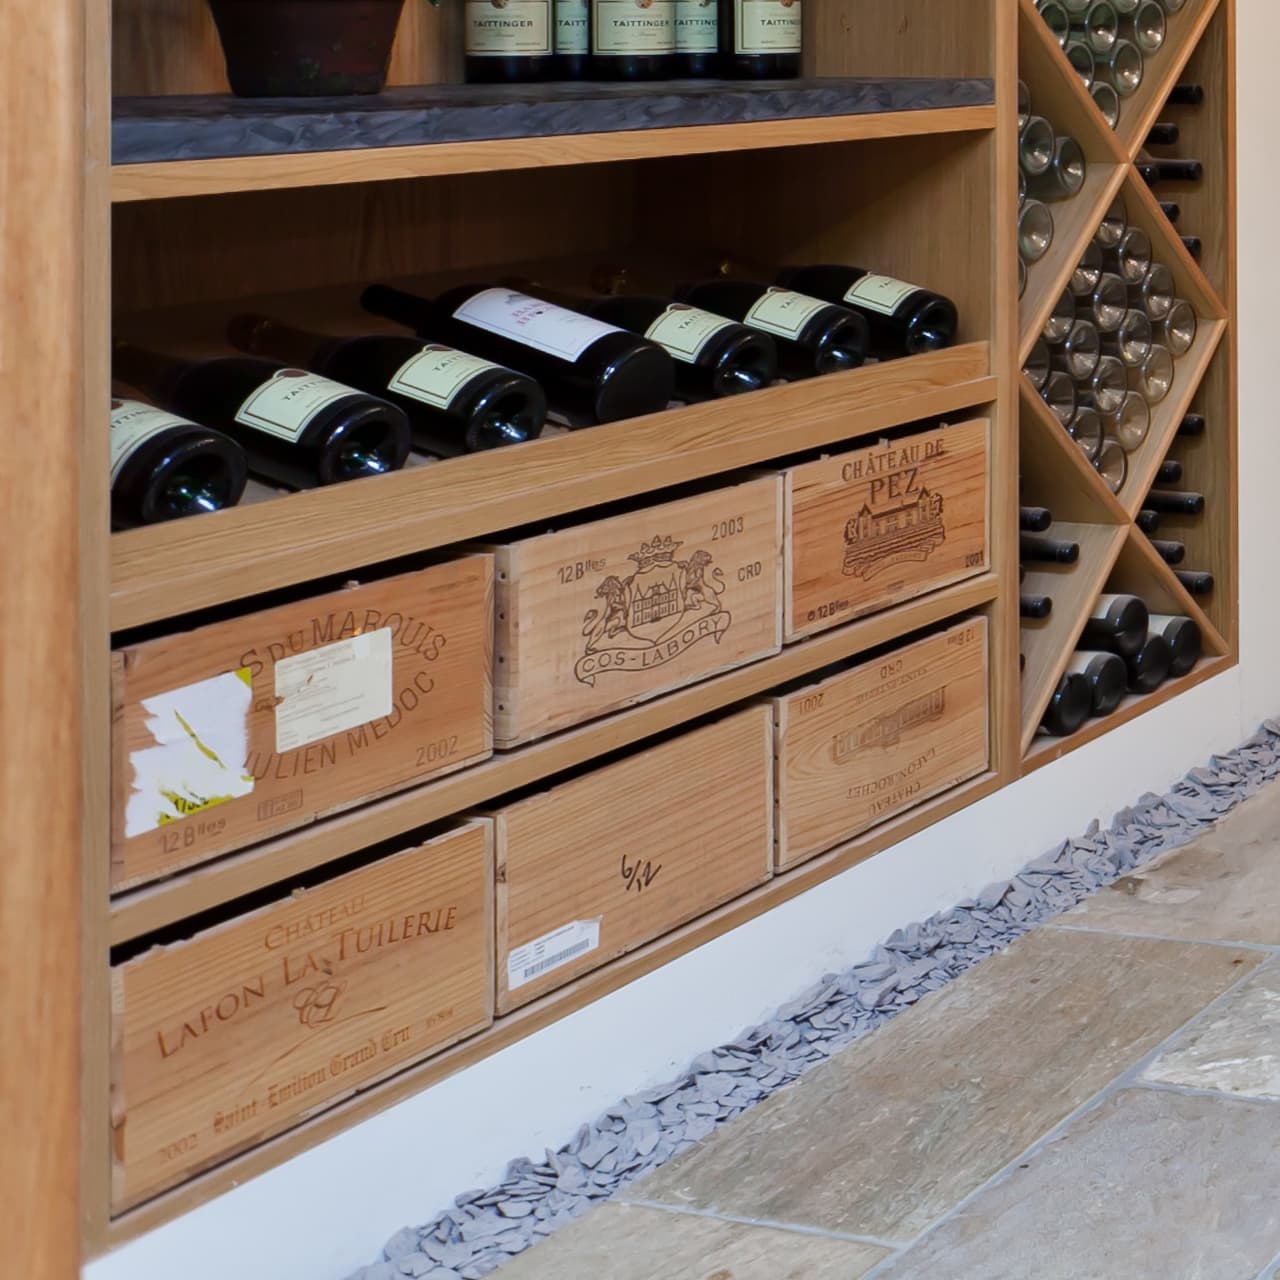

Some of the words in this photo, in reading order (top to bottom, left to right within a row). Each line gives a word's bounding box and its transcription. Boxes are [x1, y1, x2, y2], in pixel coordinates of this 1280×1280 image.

[924, 438, 946, 459] DE
[870, 468, 919, 505] PEZ
[711, 516, 744, 541] 2003
[737, 561, 762, 582] CRD
[311, 608, 447, 662] MARQUIS
[582, 615, 725, 673] COS-LABORY
[415, 735, 458, 767] 2002
[156, 975, 265, 1059] LAFON
[282, 953, 319, 986] LA
[334, 906, 457, 963] TUILERIE
